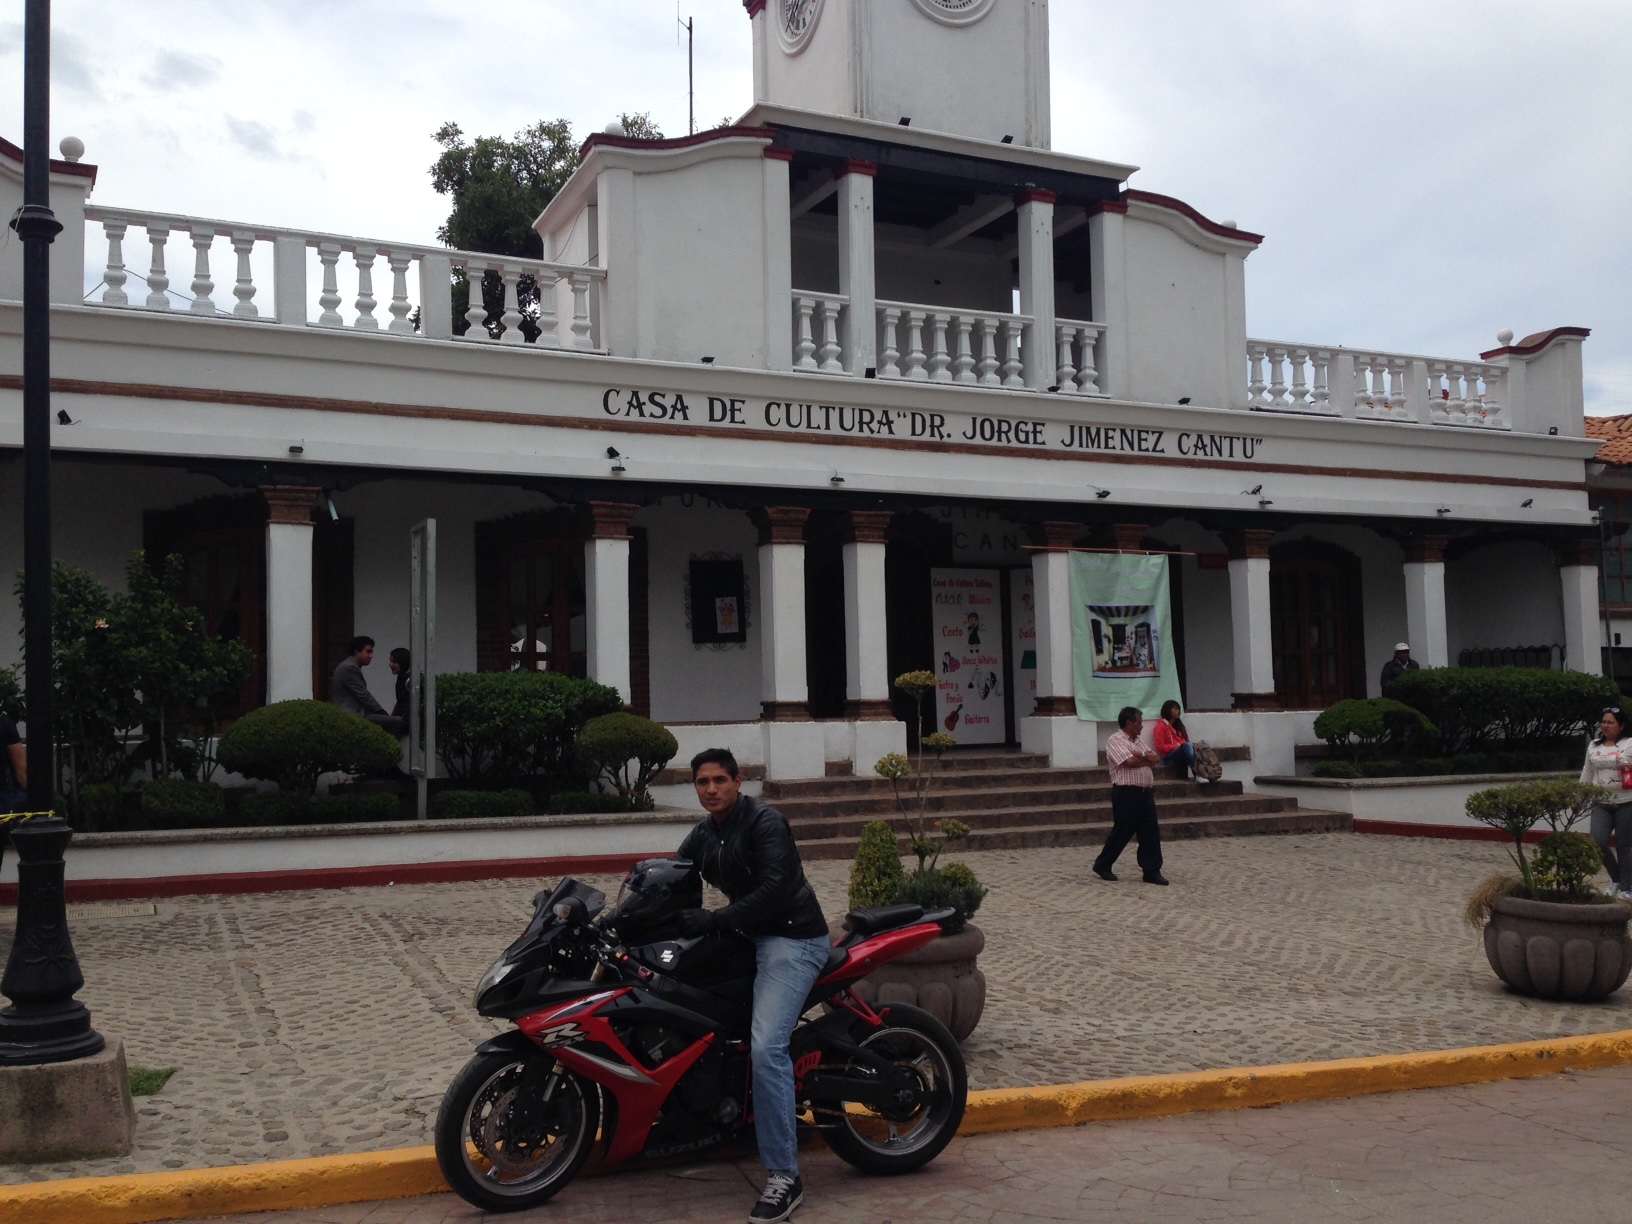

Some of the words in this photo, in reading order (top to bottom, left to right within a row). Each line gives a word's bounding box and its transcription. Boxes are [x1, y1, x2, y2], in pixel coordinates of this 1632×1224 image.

[602, 388, 690, 421] CASA
[707, 396, 747, 425] DE
[764, 401, 896, 436] CULTURA
[962, 416, 1047, 446] JORGE
[1060, 424, 1166, 454] JIMENEZ
[942, 625, 963, 637] Canto
[938, 680, 954, 690] Teatro
[964, 713, 990, 725] Guitarra
[644, 1132, 722, 1159] SUZUKI
